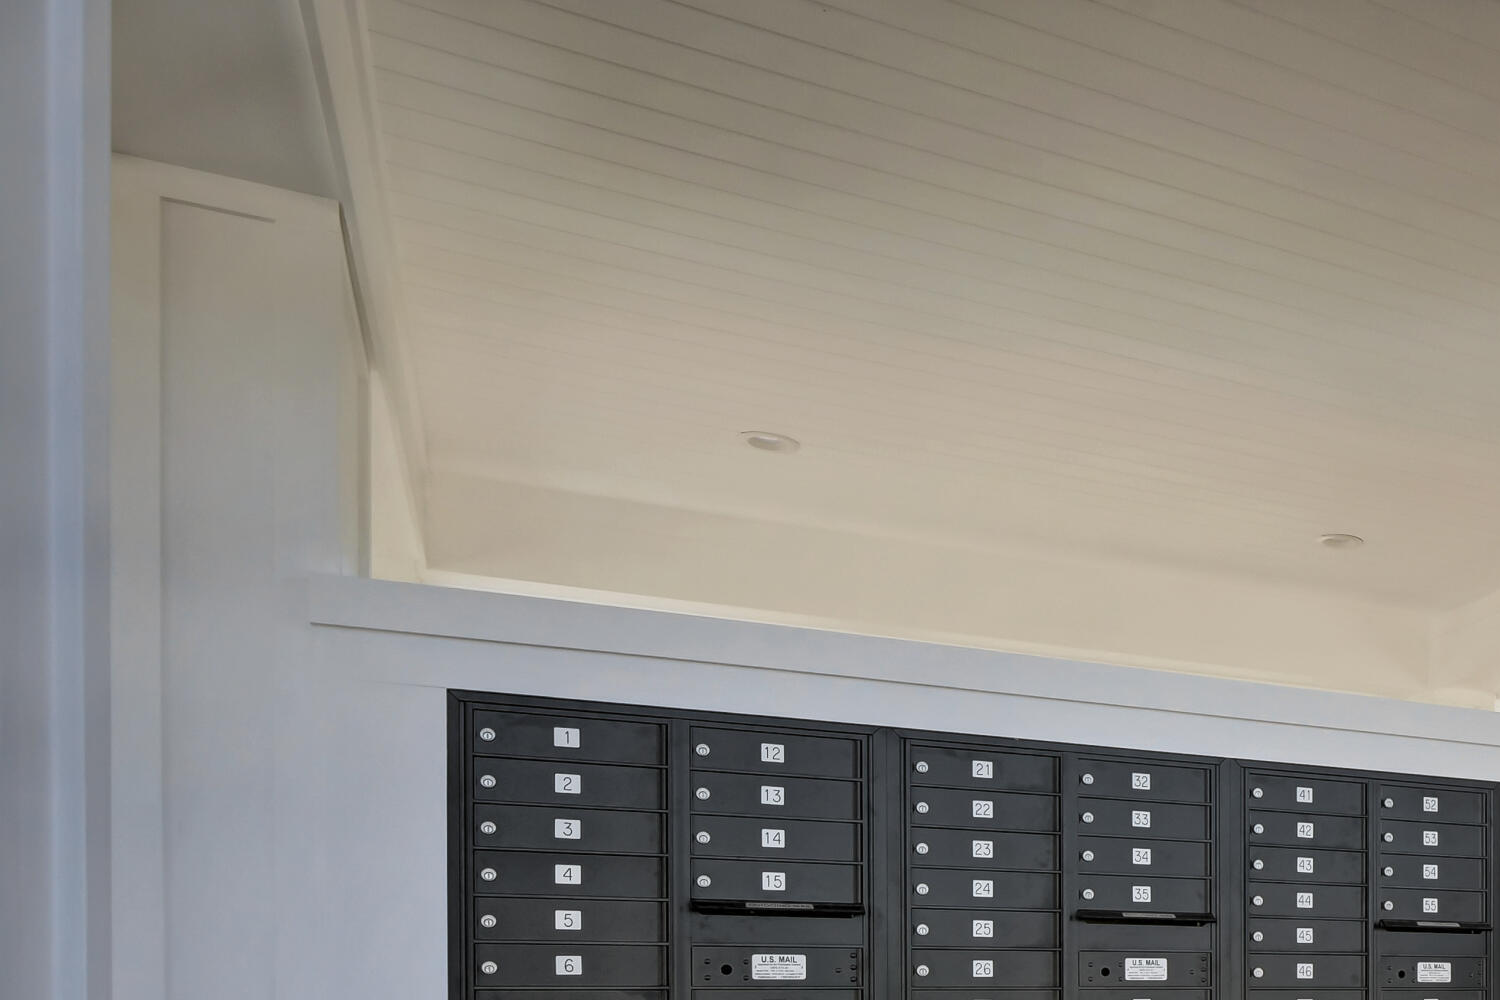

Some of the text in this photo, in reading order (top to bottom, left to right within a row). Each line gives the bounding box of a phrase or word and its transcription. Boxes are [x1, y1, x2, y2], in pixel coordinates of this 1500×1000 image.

[765, 746, 781, 761] 12
[976, 762, 990, 776] 21
[563, 776, 572, 791] 2
[1134, 775, 1148, 788] 32
[765, 788, 782, 803] 13
[1299, 789, 1310, 800] 41
[975, 802, 991, 816] 22
[1425, 798, 1436, 810] 52
[1134, 812, 1149, 826] 33
[562, 821, 573, 837] 3
[1299, 824, 1312, 837] 42
[765, 831, 781, 845] 14
[1425, 833, 1437, 844] 53
[974, 842, 991, 856] 23
[1134, 850, 1149, 863] 34
[1298, 859, 1312, 871] 43
[1425, 866, 1436, 878] 54
[562, 867, 573, 881] 4
[766, 874, 783, 889] 15
[975, 882, 991, 895] 24
[1134, 888, 1149, 901] 35
[1298, 894, 1311, 906] 44
[1425, 900, 1437, 911] 55
[563, 913, 574, 928] 5
[975, 922, 991, 936] 25
[1298, 930, 1312, 942] 45
[564, 958, 574, 973] 6
[975, 962, 991, 976] 26
[1298, 965, 1312, 977] 46
